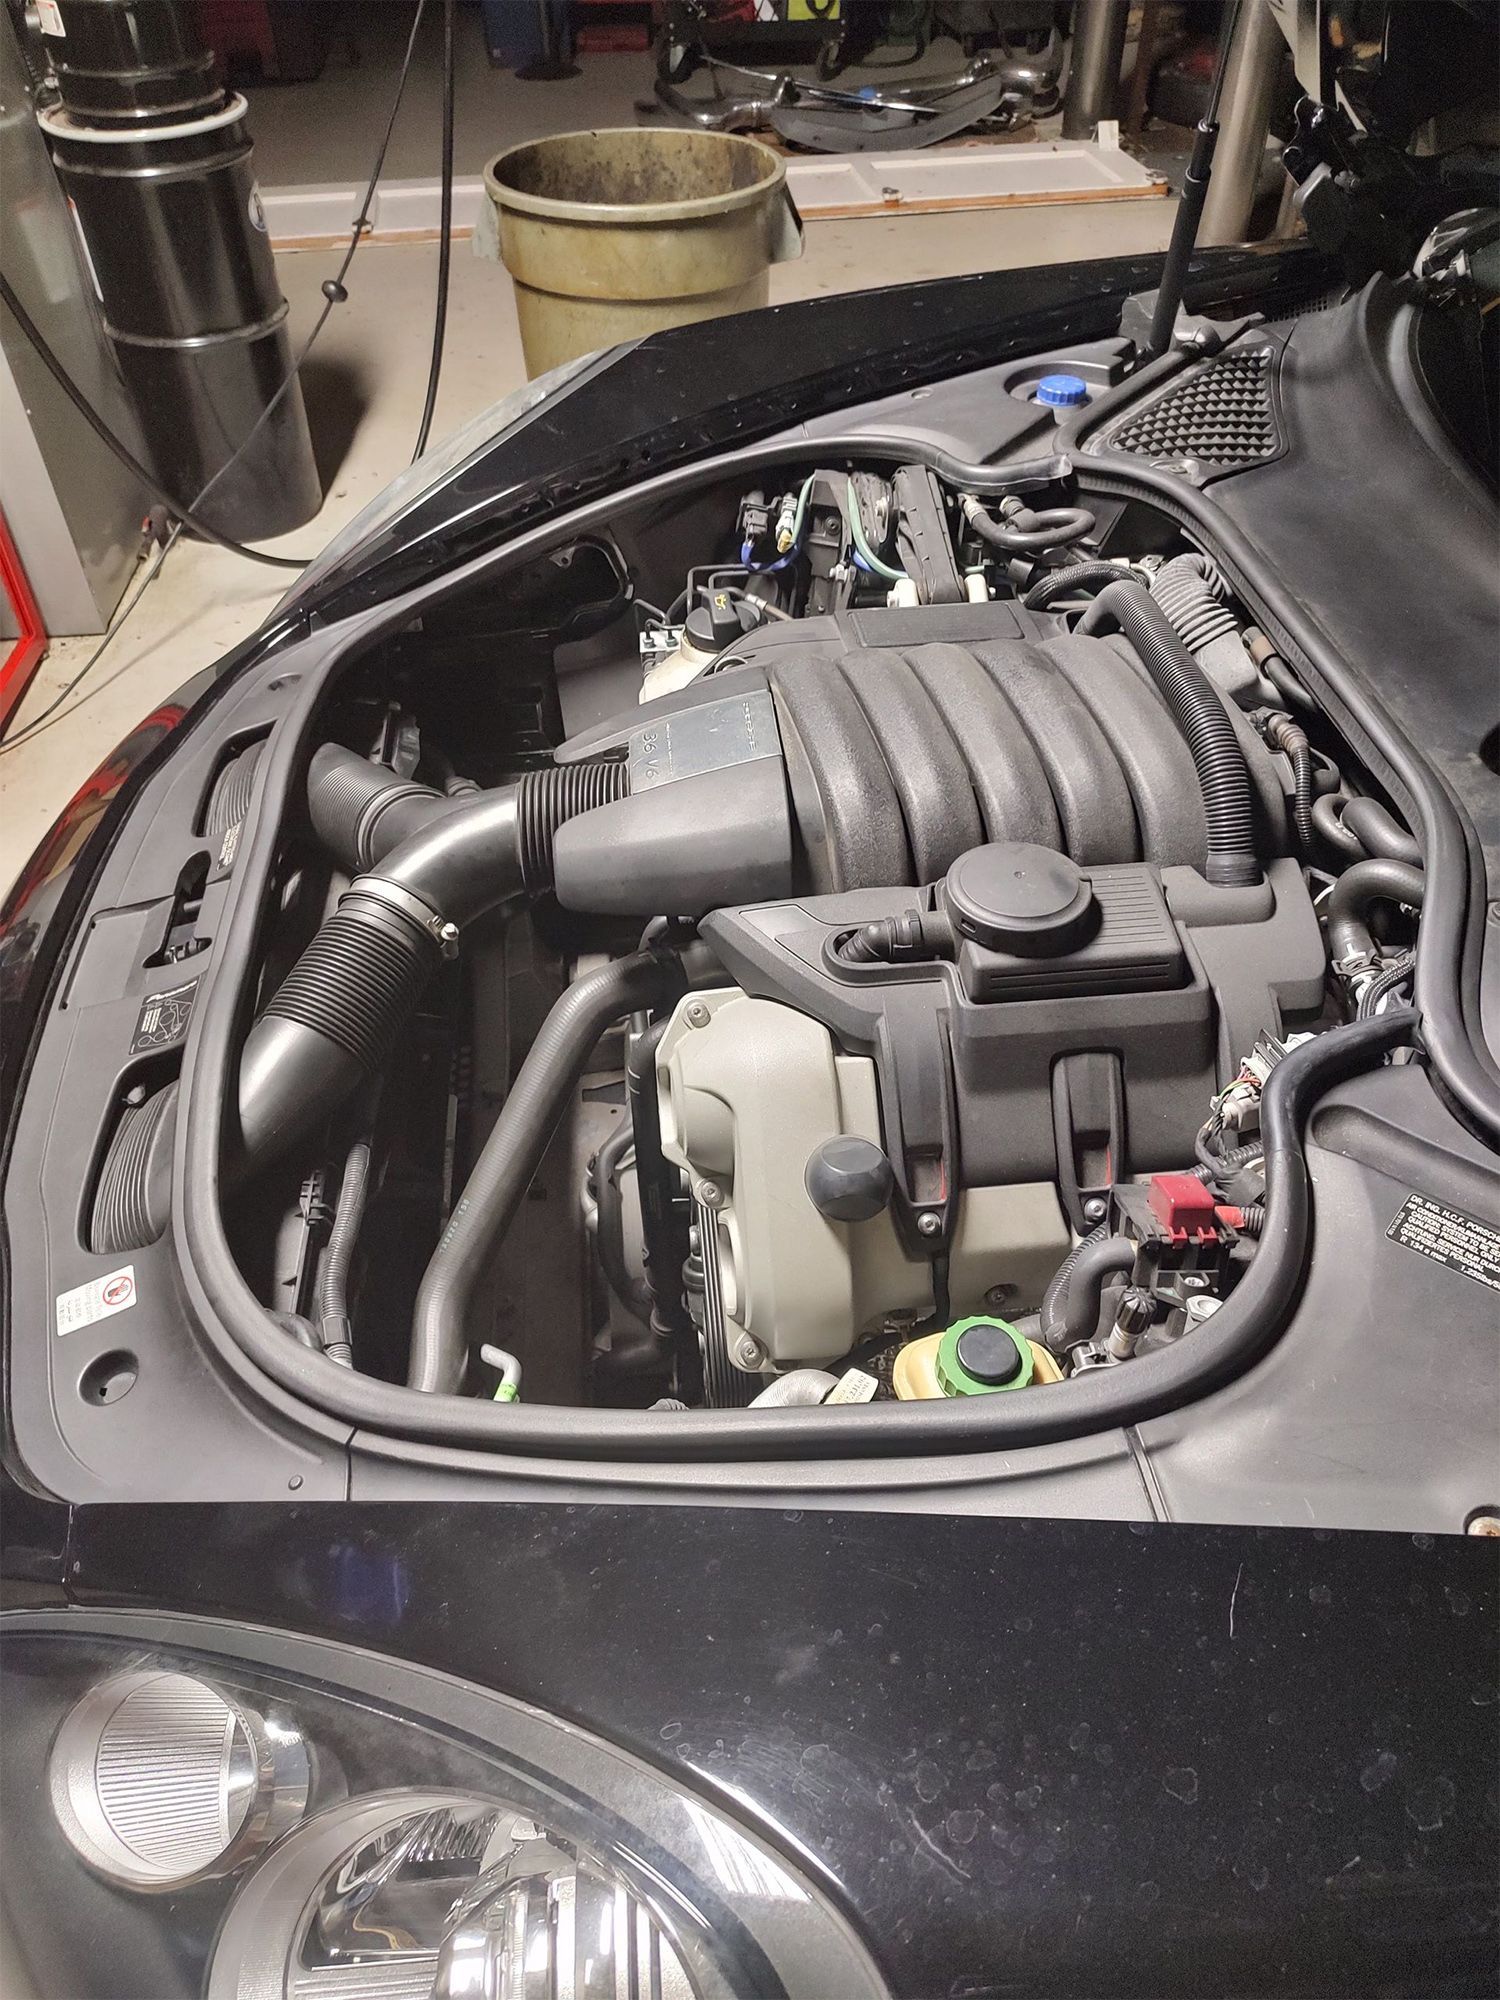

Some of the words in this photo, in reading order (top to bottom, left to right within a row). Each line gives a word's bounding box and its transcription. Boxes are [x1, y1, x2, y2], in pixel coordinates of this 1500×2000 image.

[645, 758, 659, 780] V6
[1405, 1201, 1418, 1211] AIR
[1410, 1195, 1423, 1206] DR.
[1424, 1201, 1440, 1214] ING.
[1441, 1210, 1465, 1226] H.C.F.
[1400, 1235, 1408, 1243] R
[1410, 1240, 1424, 1251] 134
[1430, 1251, 1448, 1263] max
[1408, 1216, 1440, 1235] QUALIFIED
[1440, 1231, 1479, 1254] PERSONNEL
[1480, 1250, 1500, 1263] ONLY
[1436, 1238, 1465, 1256] SERVICE
[1464, 1251, 1480, 1263] NUR
[1441, 1225, 1469, 1242] SYSTEM
[1469, 1237, 1479, 1247] TO
[1479, 1242, 1490, 1252] BE
[1449, 1250, 1484, 1273] PERSONAL
